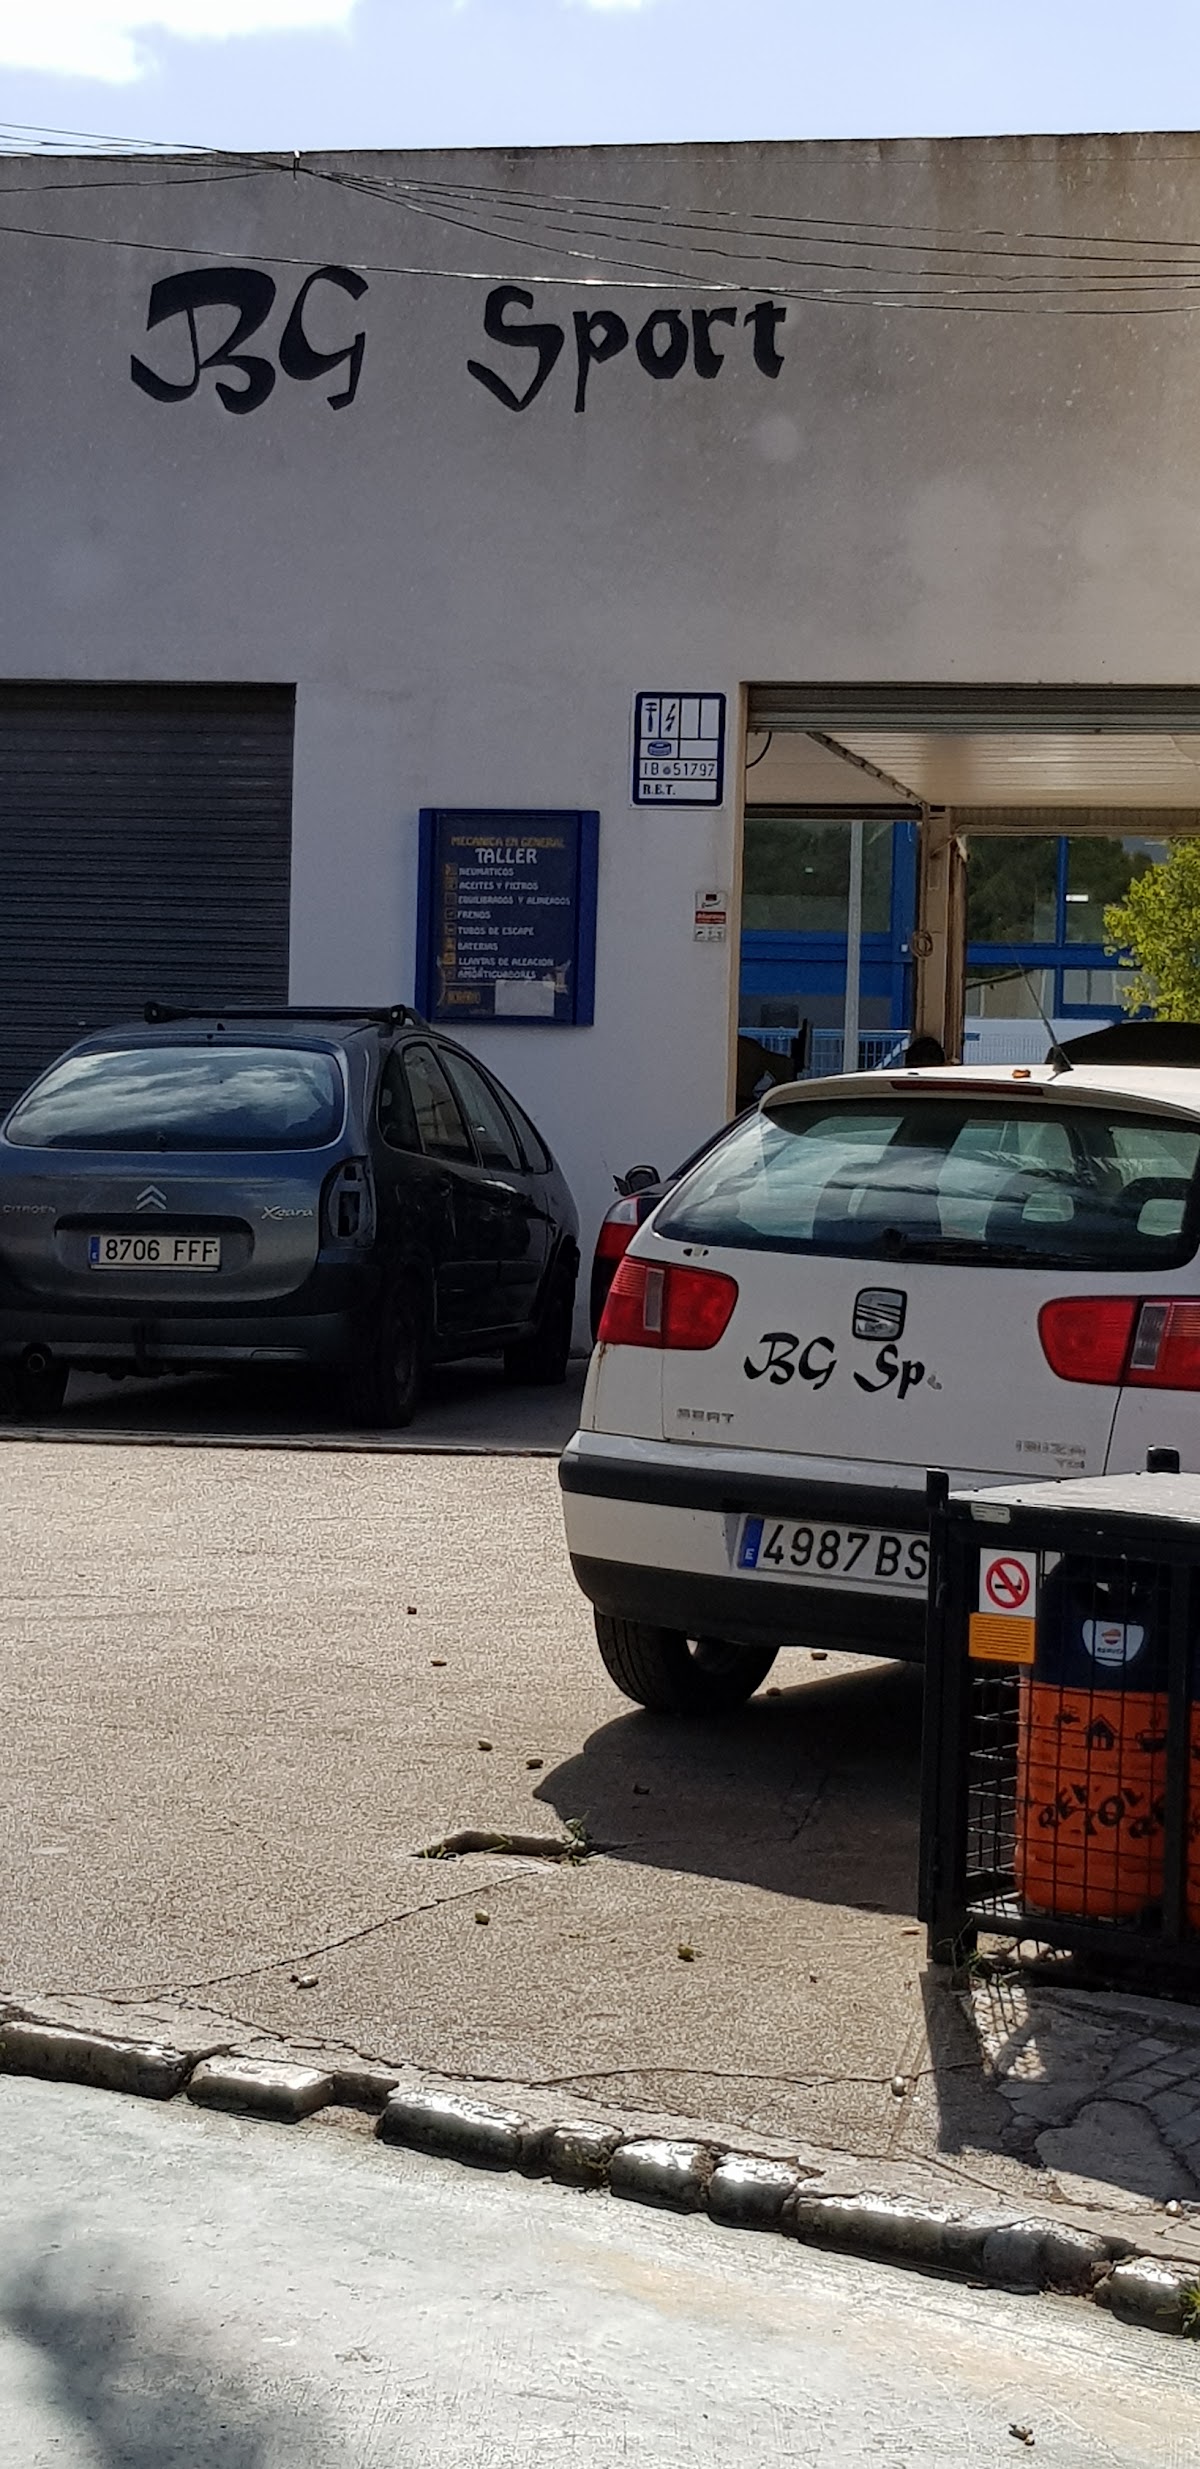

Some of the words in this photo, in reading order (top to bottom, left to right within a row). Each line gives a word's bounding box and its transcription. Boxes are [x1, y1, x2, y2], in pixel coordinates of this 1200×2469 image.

[130, 265, 369, 416] BG
[466, 285, 787, 414] Sport
[673, 763, 715, 776] 51797
[642, 784, 676, 796] R.E.T.
[475, 849, 537, 863] TALLER
[458, 881, 494, 891] ACEITES
[457, 910, 492, 920] FRENOS
[457, 926, 487, 936] TUBOS
[488, 927, 500, 936] DE
[502, 927, 535, 936] ESCAPE
[457, 942, 499, 952] BATERIAS
[458, 957, 496, 967] LLANTAS
[498, 957, 510, 967] DE
[105, 1239, 161, 1261] 8706
[173, 1240, 216, 1262] FFF
[744, 1332, 837, 1391] BG
[854, 1344, 942, 1400] Sp
[763, 1524, 870, 1572] 4987
[874, 1535, 929, 1580] BS
